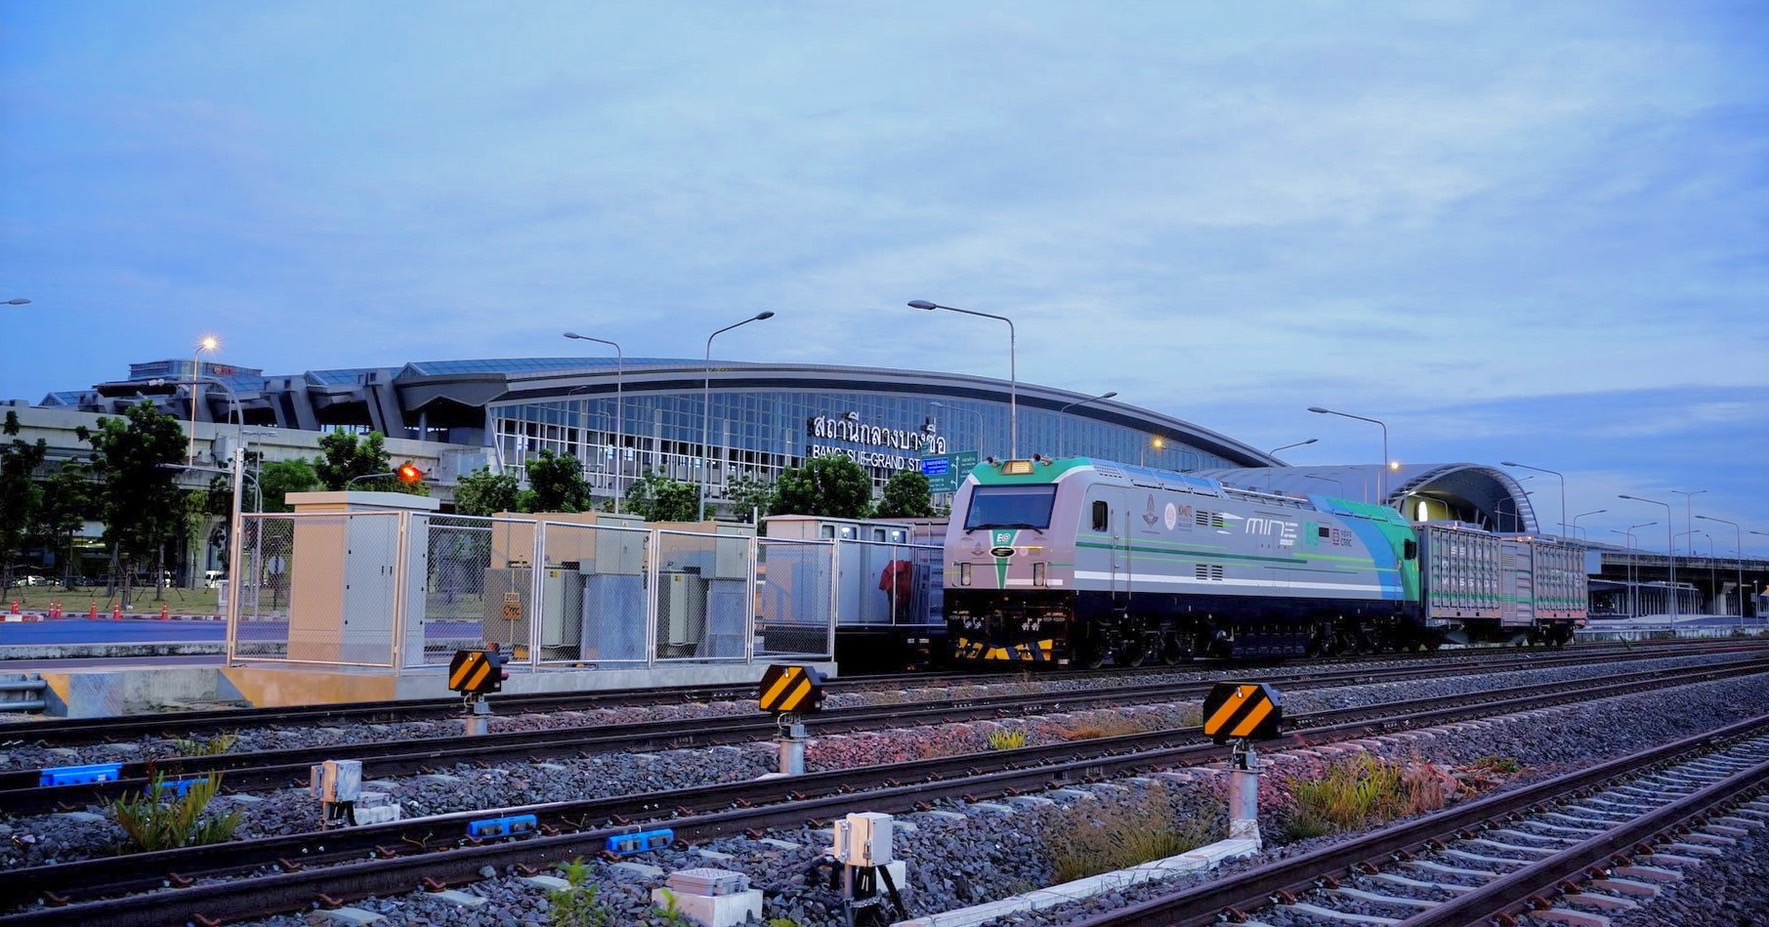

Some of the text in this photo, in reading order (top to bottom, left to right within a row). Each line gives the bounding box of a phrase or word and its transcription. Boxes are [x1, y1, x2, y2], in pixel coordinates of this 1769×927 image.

[813, 410, 946, 454] สถานีกลางบางซื่อ
[847, 449, 865, 467] SUE
[870, 452, 905, 470] GRAND
